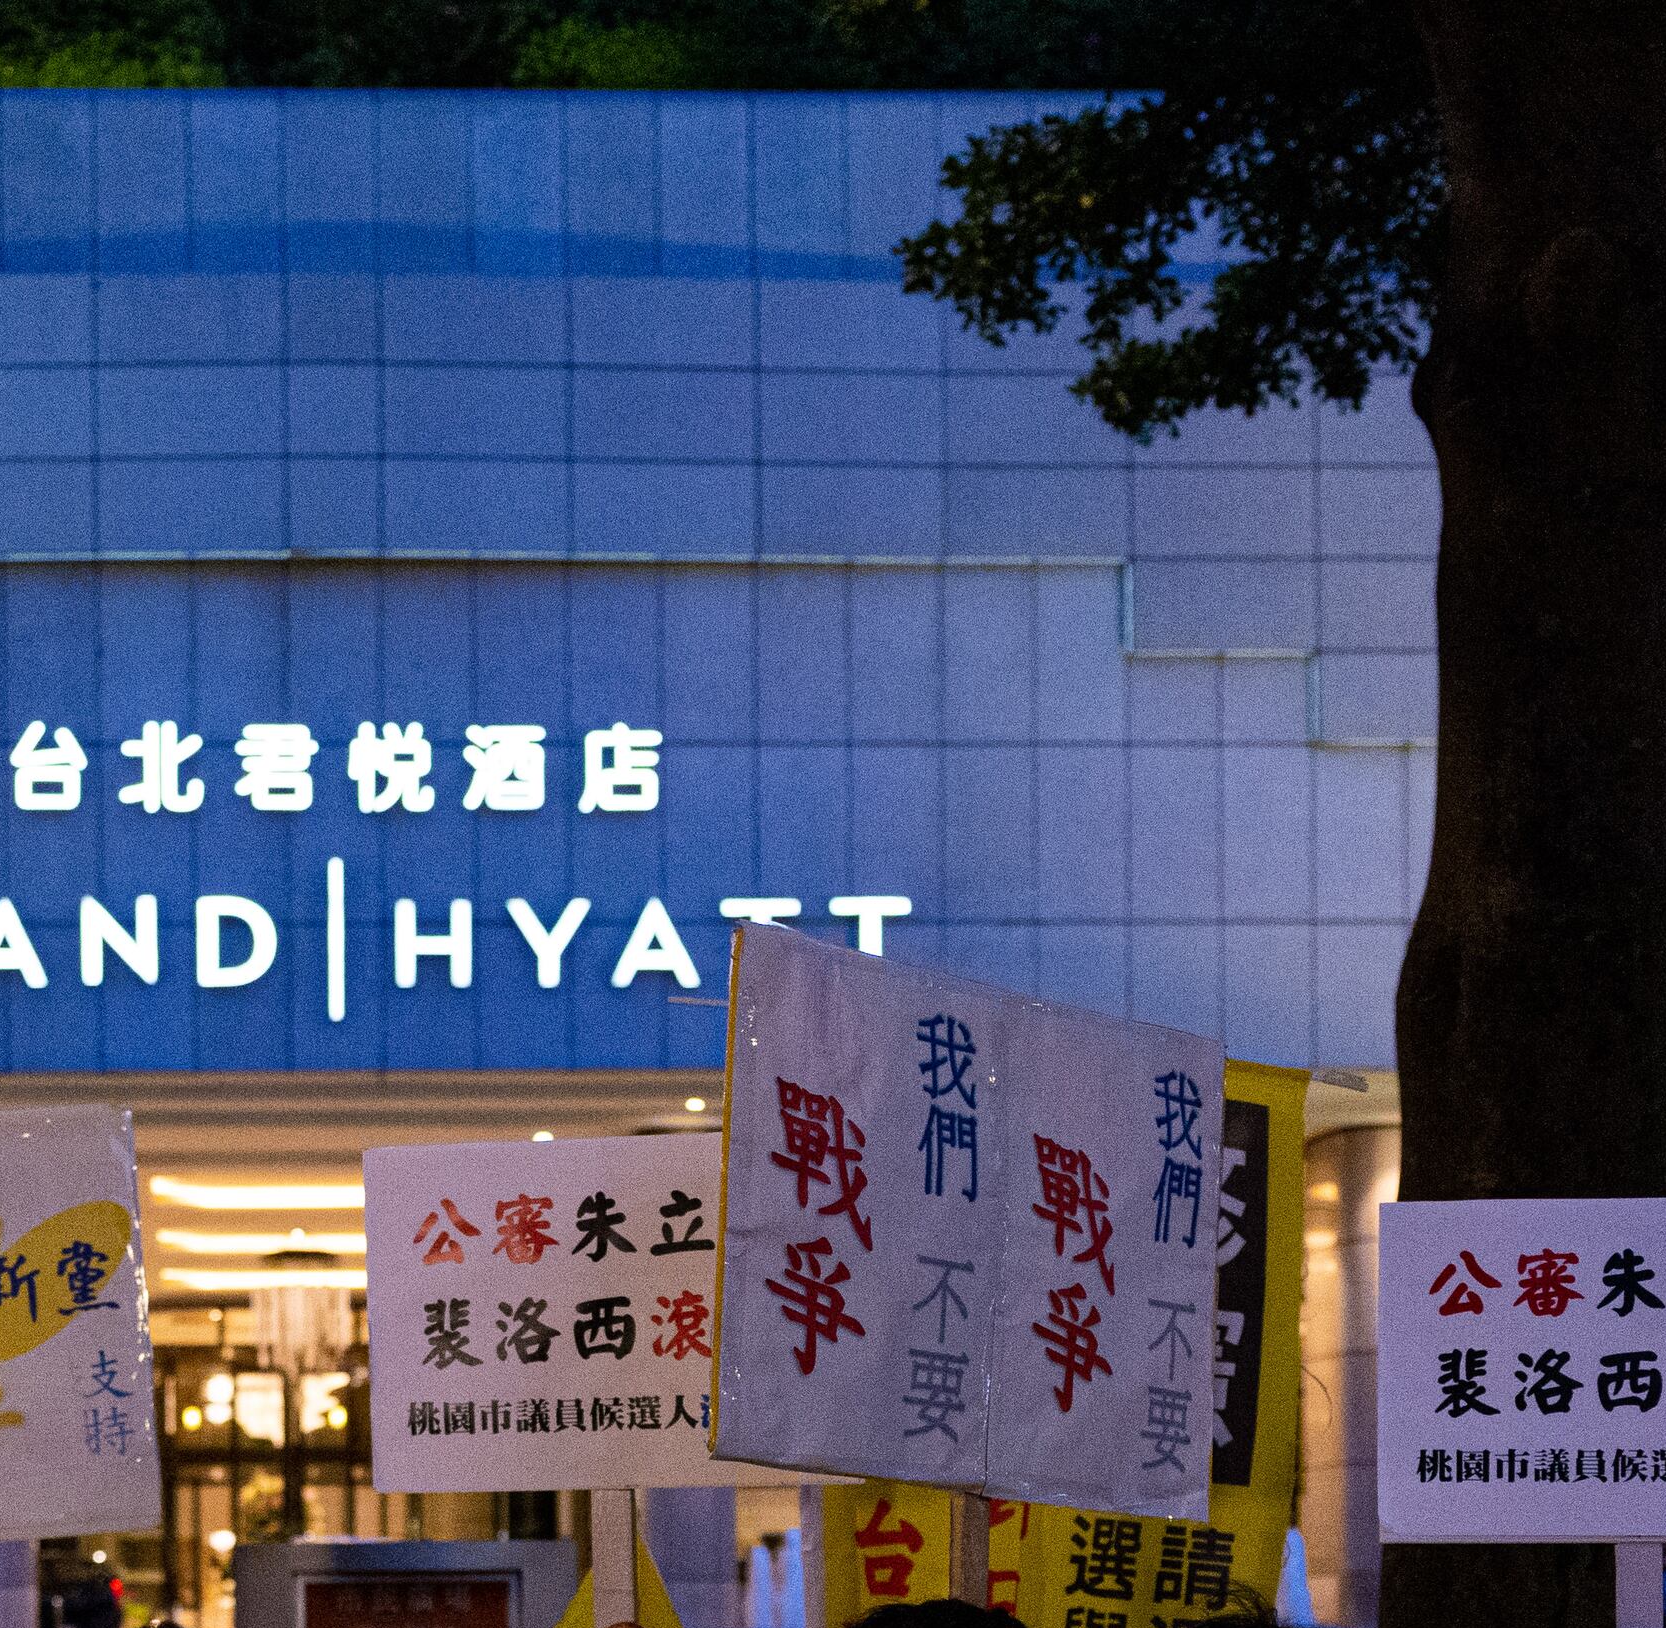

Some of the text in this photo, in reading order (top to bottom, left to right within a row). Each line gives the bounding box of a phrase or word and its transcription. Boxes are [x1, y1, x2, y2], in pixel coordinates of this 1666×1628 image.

[9, 719, 664, 814] 台北君悦酒店
[413, 1190, 717, 1266] 公審朱立
[765, 1076, 873, 1376] 戰爭
[1032, 1132, 1116, 1414] 戰爭
[81, 1349, 135, 1458] 支持
[407, 1393, 712, 1437] 桃園市議員候選人
